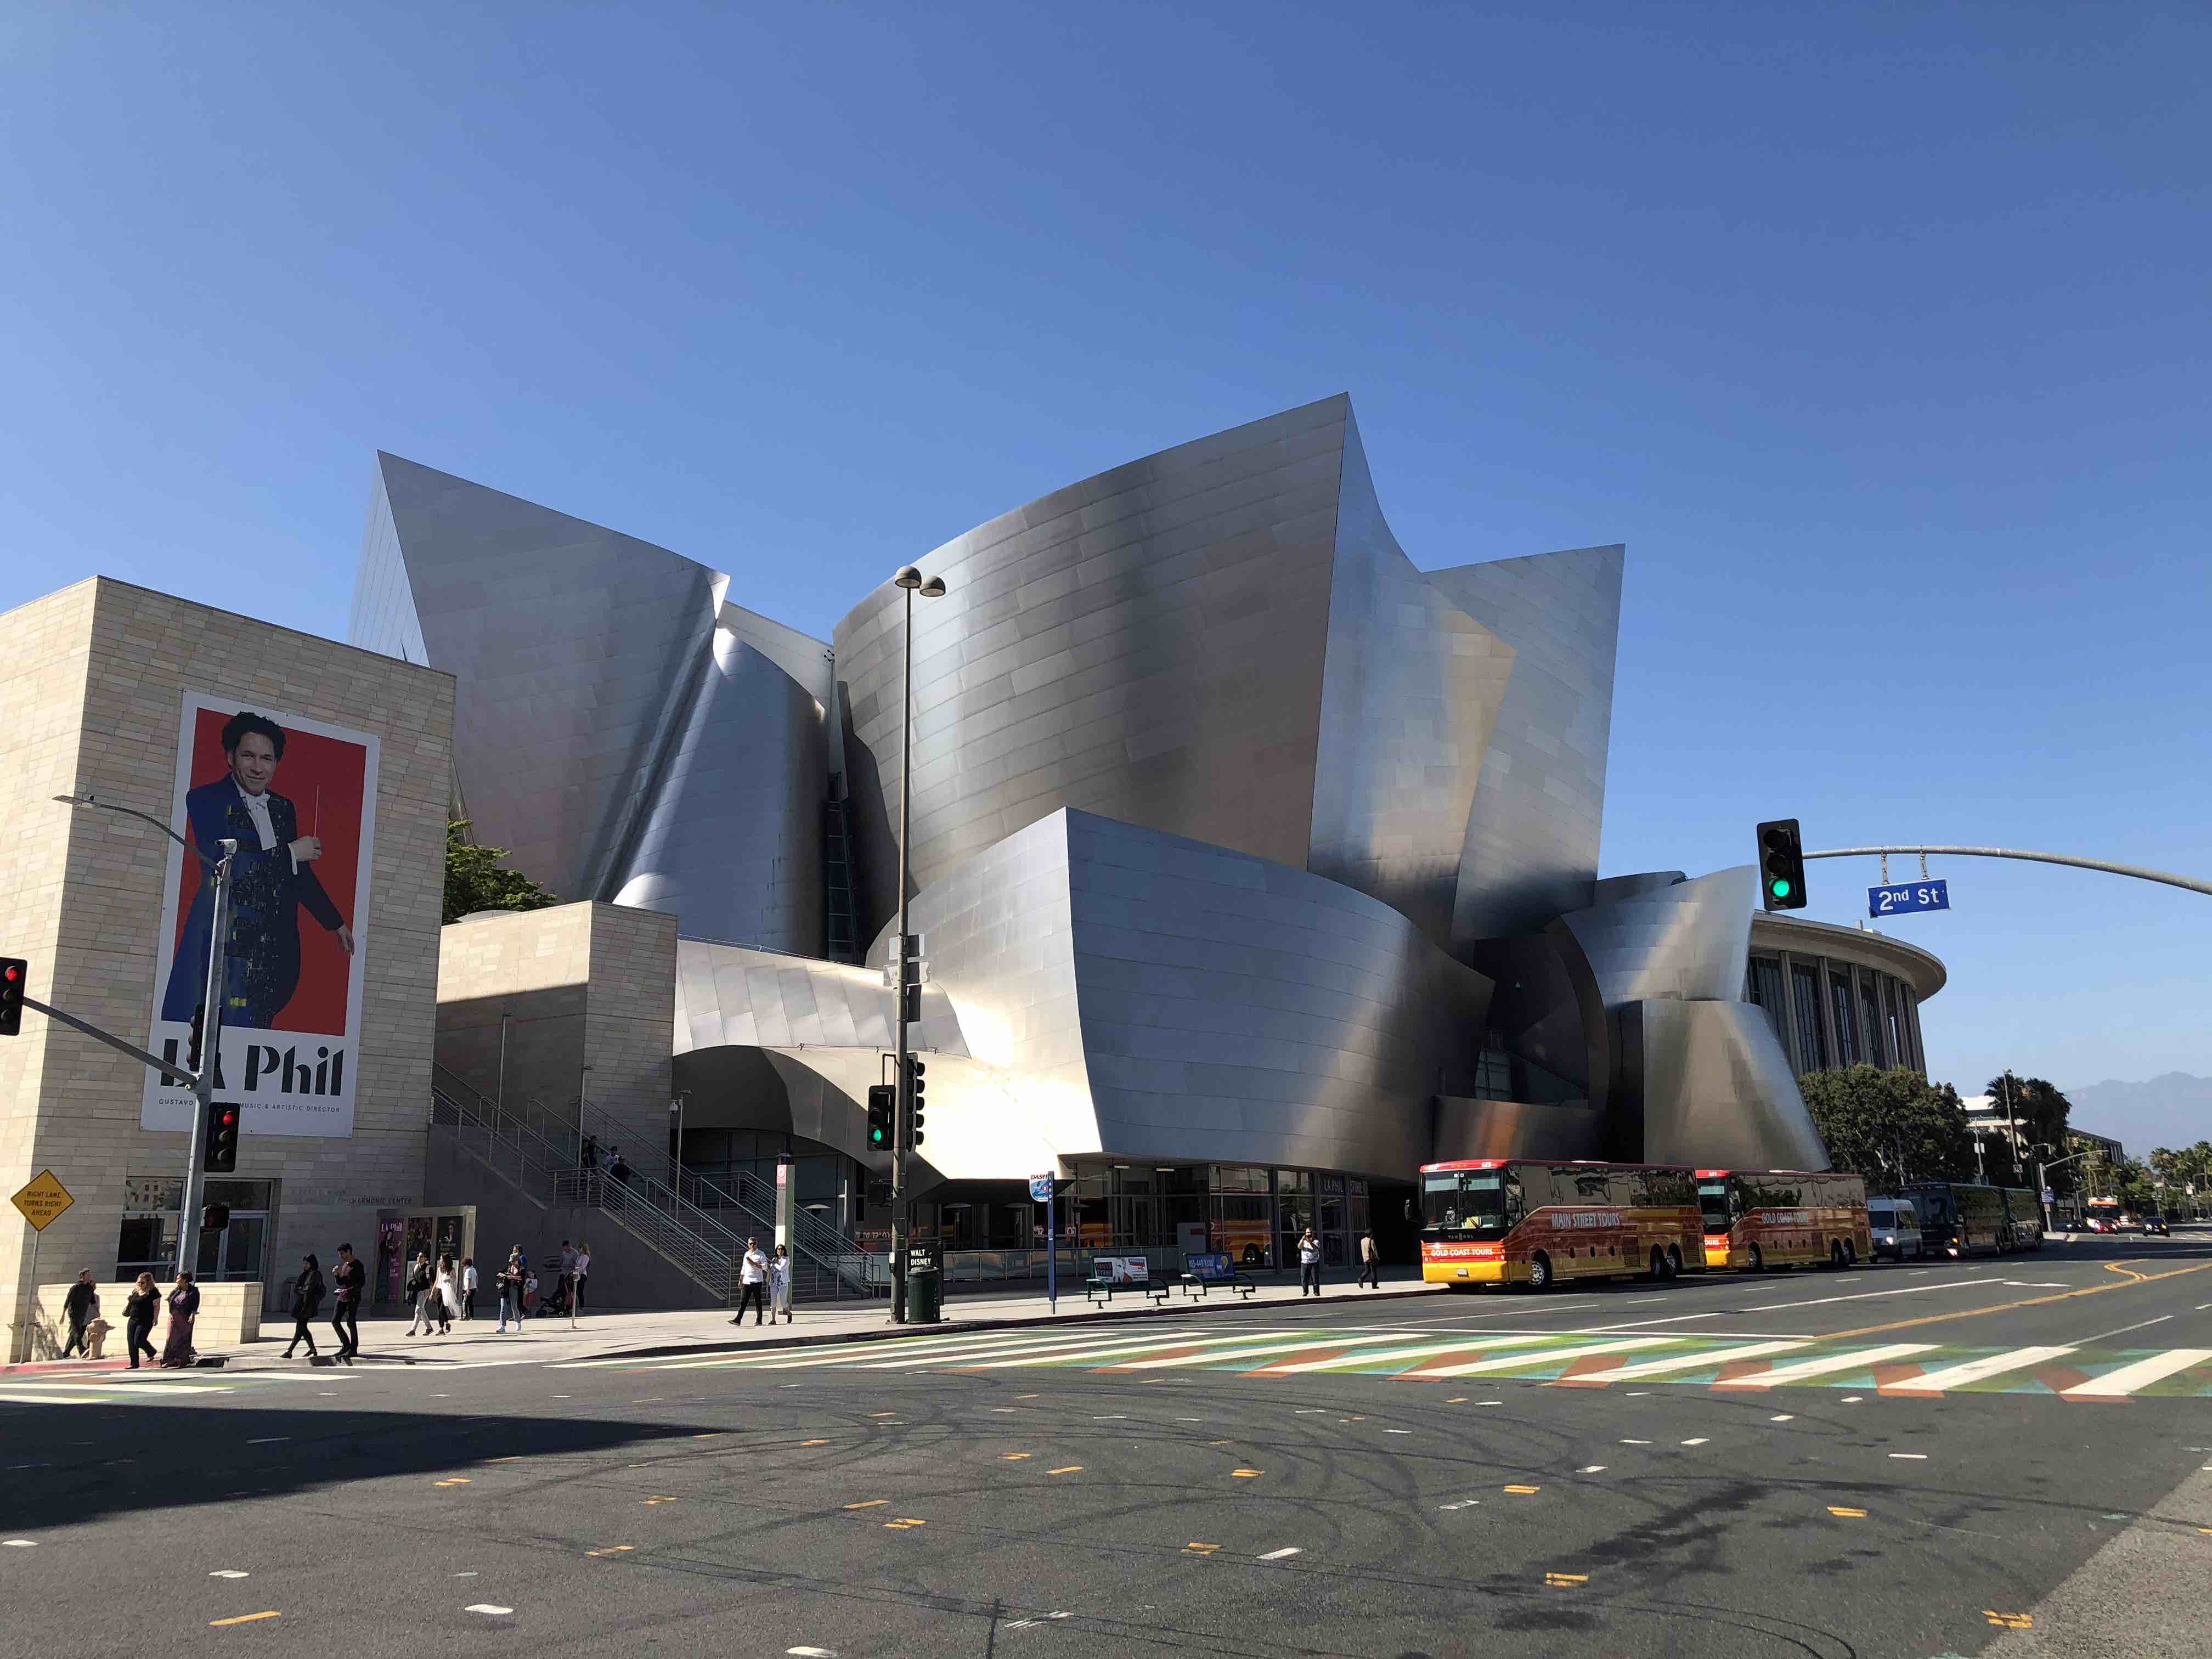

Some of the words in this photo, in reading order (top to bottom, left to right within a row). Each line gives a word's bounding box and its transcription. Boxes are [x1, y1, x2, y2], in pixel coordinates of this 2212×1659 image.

[1878, 889, 1910, 911] 2nd
[1918, 888, 1939, 904] St
[244, 1045, 344, 1096] Phil
[159, 1098, 194, 1107] GUSTAVO
[1551, 1212, 1571, 1228] MAIN
[1572, 1212, 1596, 1228] STREET
[1598, 1212, 1620, 1227] TOURS
